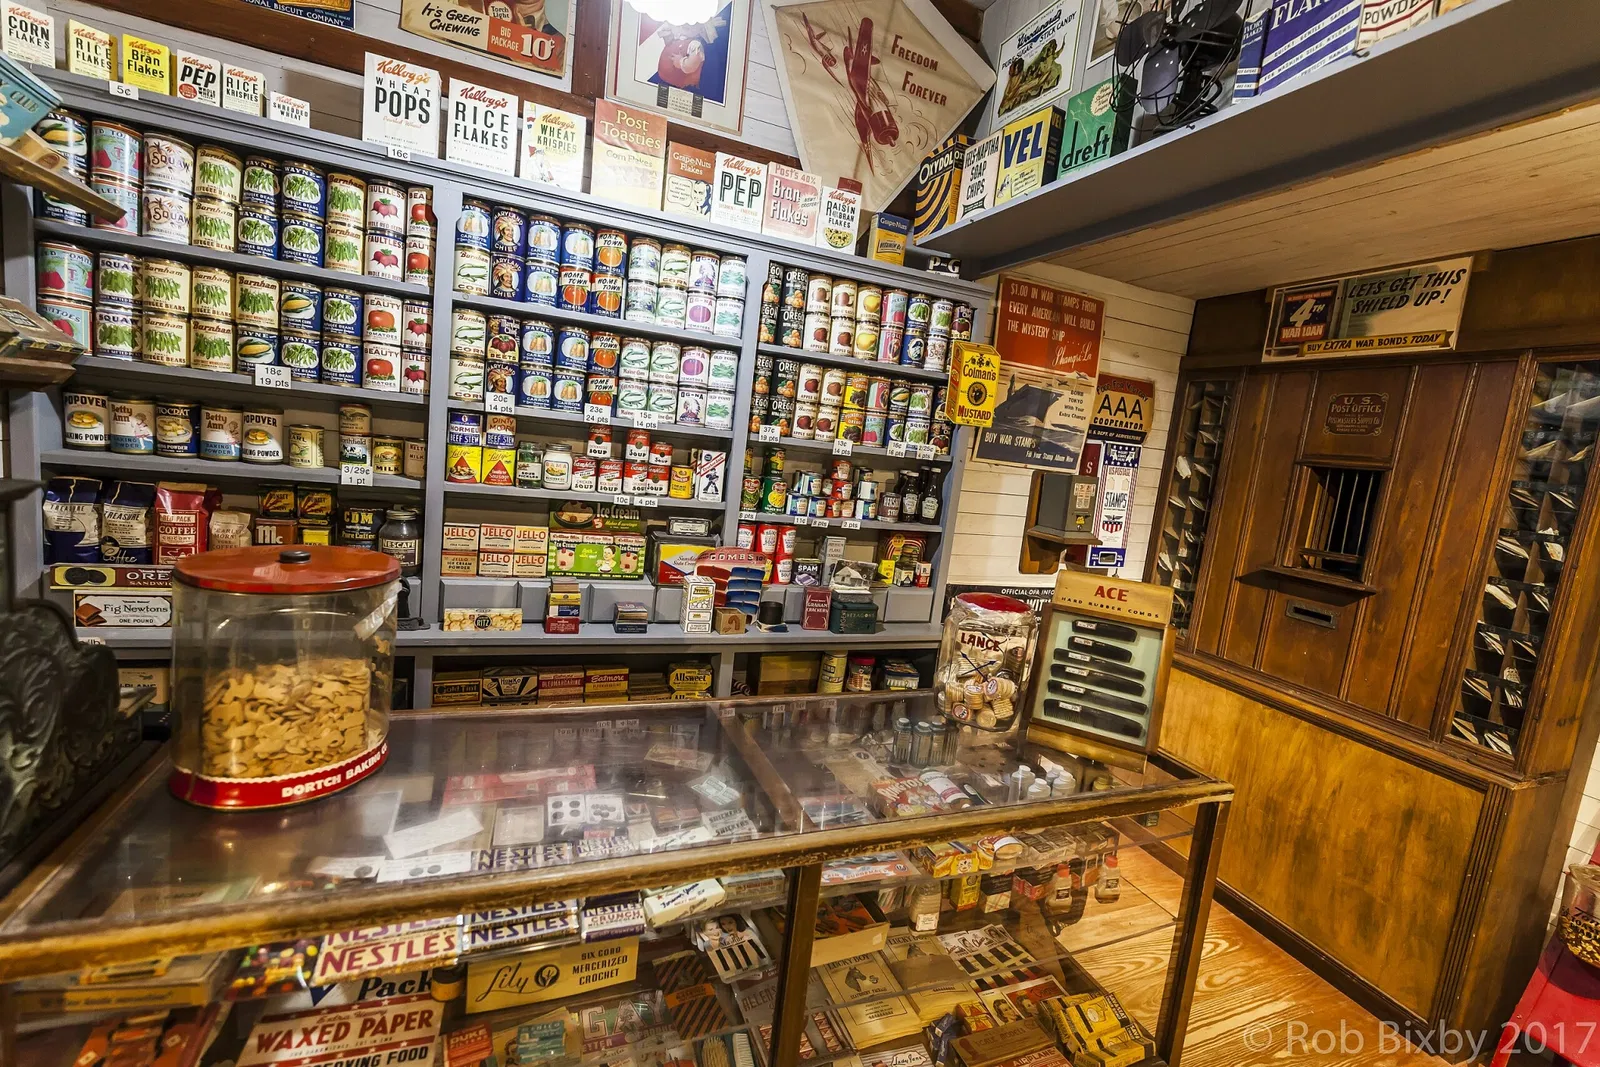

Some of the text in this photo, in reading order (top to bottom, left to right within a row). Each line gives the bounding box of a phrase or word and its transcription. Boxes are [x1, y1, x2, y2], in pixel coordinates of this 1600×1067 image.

[273, 3, 304, 16] BISCUIT
[306, 12, 344, 26] COMPANY
[8, 16, 50, 40] CORN
[501, 26, 511, 38] BIG
[1040, 26, 1056, 42] STICK
[1056, 11, 1076, 31] CANDY
[1244, 18, 1264, 33] IVORY
[8, 28, 50, 50] FLAKES
[490, 35, 520, 52] PACKAGE
[520, 33, 556, 60] 10¢
[76, 37, 112, 60] RICE
[132, 49, 160, 66] Bran
[891, 34, 938, 72] FREEDOM
[128, 59, 164, 78] Flakes
[180, 65, 216, 88] PEP
[377, 60, 431, 85] Kellogg's
[226, 77, 258, 94] RICE
[375, 76, 432, 98] WHEAT
[902, 70, 948, 106] FOREVER
[226, 88, 258, 103] KRISPIES
[460, 86, 508, 109] Kellogg's
[273, 102, 308, 118] SHREDDED
[374, 86, 431, 124] POPS
[455, 101, 510, 134] RICE
[616, 110, 650, 132] Post
[454, 123, 508, 150] FLAKES
[540, 123, 576, 143] WHEAT
[600, 120, 661, 150] Toasties
[536, 136, 577, 154] KRISPIES
[1002, 122, 1043, 170] VEL
[1062, 120, 1111, 169] dreft
[152, 150, 190, 172] SQUAW
[606, 150, 652, 168] Corn Flakes
[920, 151, 954, 185] OXYDOL
[775, 164, 816, 184] Post's 40%
[970, 161, 987, 182] SOAP
[720, 171, 762, 208] PEP
[772, 178, 799, 202] Bran
[966, 178, 986, 200] CHIPS
[153, 204, 190, 224] SQUAW
[770, 202, 808, 226] Flakes
[826, 200, 856, 217] RAISIN
[838, 212, 854, 222] BRAN
[494, 210, 524, 226] MARYLAND
[368, 234, 405, 250] FAULTLESS
[1390, 276, 1420, 292] GET
[1423, 268, 1467, 288] THIS
[494, 289, 516, 298] CHIEF
[1010, 283, 1028, 296] $1.00
[1031, 288, 1038, 298] IN
[1041, 290, 1054, 302] WAR
[1082, 300, 1097, 313] FROM
[1352, 295, 1408, 314] SHIELD
[1414, 288, 1452, 306] UP!
[365, 298, 400, 310] BEAUTY
[1008, 301, 1096, 330] EVERY AMERICAN WILL BUILD
[1007, 320, 1019, 332] THE
[1022, 322, 1050, 338] MYSTERY
[1282, 324, 1324, 339] WAR LOAN
[1307, 332, 1442, 352] BUY EXTRA WAR BONDS TODAY
[260, 376, 290, 388] 19 pts
[962, 364, 996, 382] Colman's
[111, 404, 132, 416] Betty
[959, 406, 992, 422] MUSTARD
[1098, 394, 1142, 420] AAA
[1331, 404, 1382, 413] POST OFFICE
[113, 413, 130, 423] Ann
[206, 412, 227, 424] Betty
[492, 417, 514, 425] DINTY
[1094, 417, 1144, 430] COOPERATOR
[450, 426, 479, 434] HORMEL
[985, 431, 1036, 448] BUY WAR STAMPS
[1104, 492, 1128, 510] STAMPS
[104, 511, 140, 521] TREASURE
[596, 503, 640, 520] Ice Cream
[159, 526, 196, 534] COFFEE
[482, 528, 514, 538] JELL-O
[102, 548, 138, 564] Coffee
[480, 552, 510, 564] JELL-O
[710, 554, 754, 562] COMBS
[1094, 586, 1130, 602] ACE
[104, 604, 168, 614] Fig Newtons
[1088, 602, 1122, 612] RUBBER
[1128, 608, 1160, 618] COMBS
[476, 619, 490, 628] RITZ
[961, 632, 1000, 652] LANCE
[591, 674, 625, 684] Eatmore
[674, 672, 706, 682] Allsweet
[282, 774, 341, 798] DORTCH
[346, 752, 381, 780] BAKING
[591, 910, 642, 924] CRUNCH
[471, 916, 569, 944] NESTLES
[581, 946, 621, 961] SIX CORD
[828, 953, 870, 970] LUCKY BOY
[572, 954, 628, 974] MERCERIZED
[476, 962, 530, 1002] Lily
[579, 968, 620, 986] CROCHET
[582, 989, 666, 1040] GAY
[257, 1020, 351, 1054] WAXED
[358, 1009, 434, 1040] PAPER
[386, 1046, 428, 1065] FOOD
